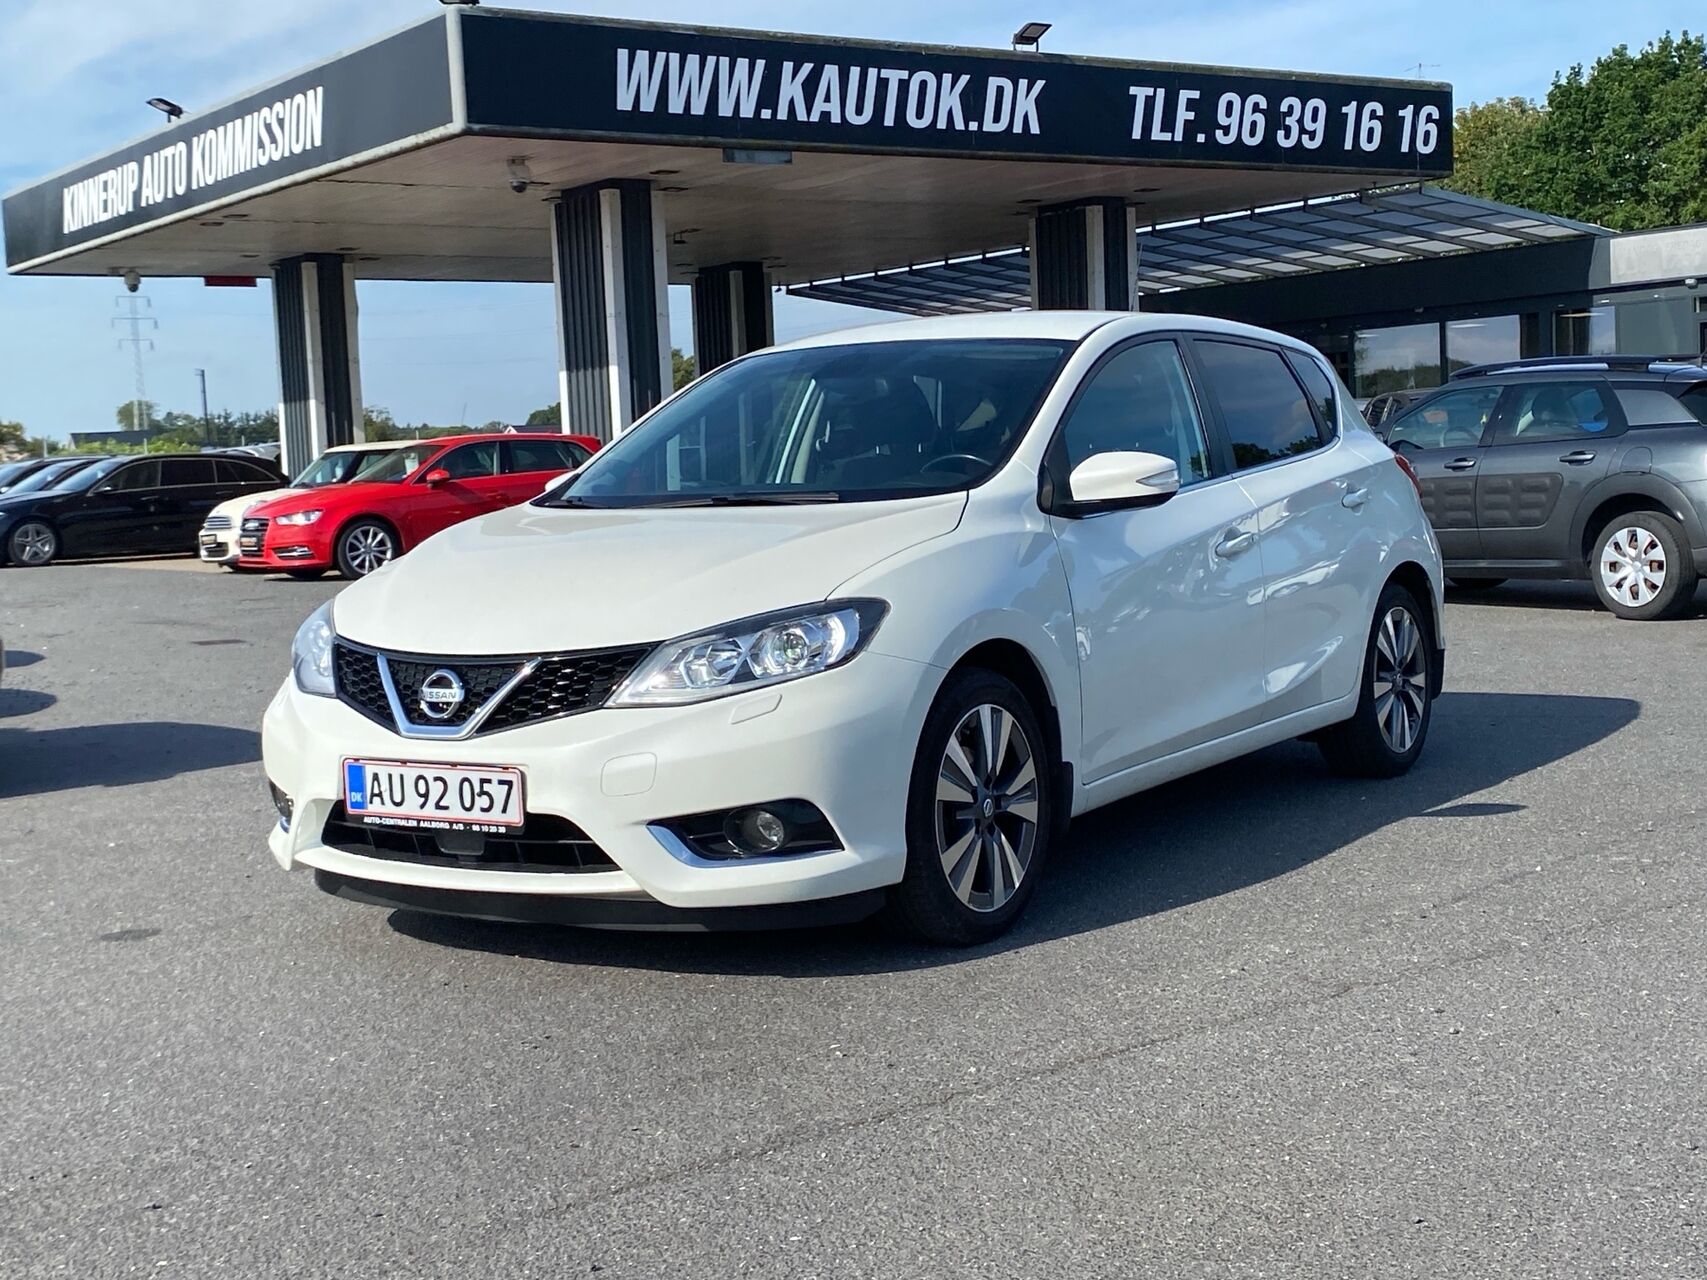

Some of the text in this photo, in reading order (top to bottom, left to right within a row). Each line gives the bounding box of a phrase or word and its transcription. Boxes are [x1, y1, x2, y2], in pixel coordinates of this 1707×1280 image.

[616, 48, 1046, 135] WWW.KAUTOK.DK
[1129, 86, 1440, 155] TLF. 96 39 16 16
[63, 86, 323, 234] KINNERUP AUTO KOMMISSION
[351, 792, 363, 802] DK
[369, 772, 513, 814] AU 92 057
[363, 816, 418, 827] AUTO-CENTRALEN
[419, 820, 450, 829] AALBORG
